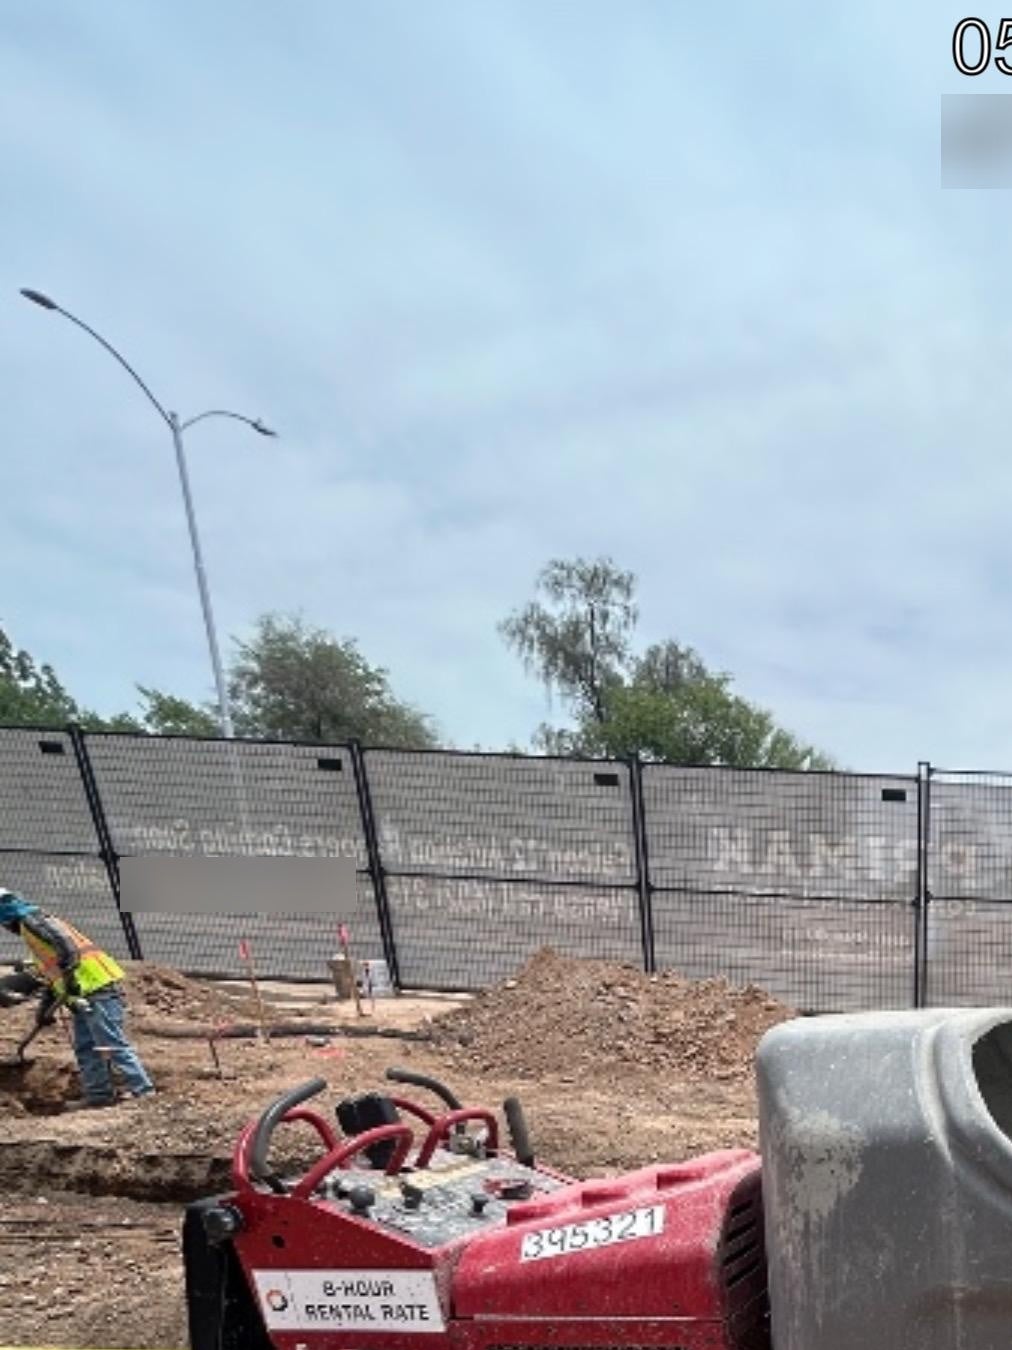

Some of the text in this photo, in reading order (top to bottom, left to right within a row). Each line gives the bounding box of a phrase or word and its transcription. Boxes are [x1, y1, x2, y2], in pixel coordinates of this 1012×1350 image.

[524, 1208, 656, 1258] 395321
[322, 1280, 396, 1297] 8-HOUR
[305, 1304, 430, 1321] RENTAL RATE
